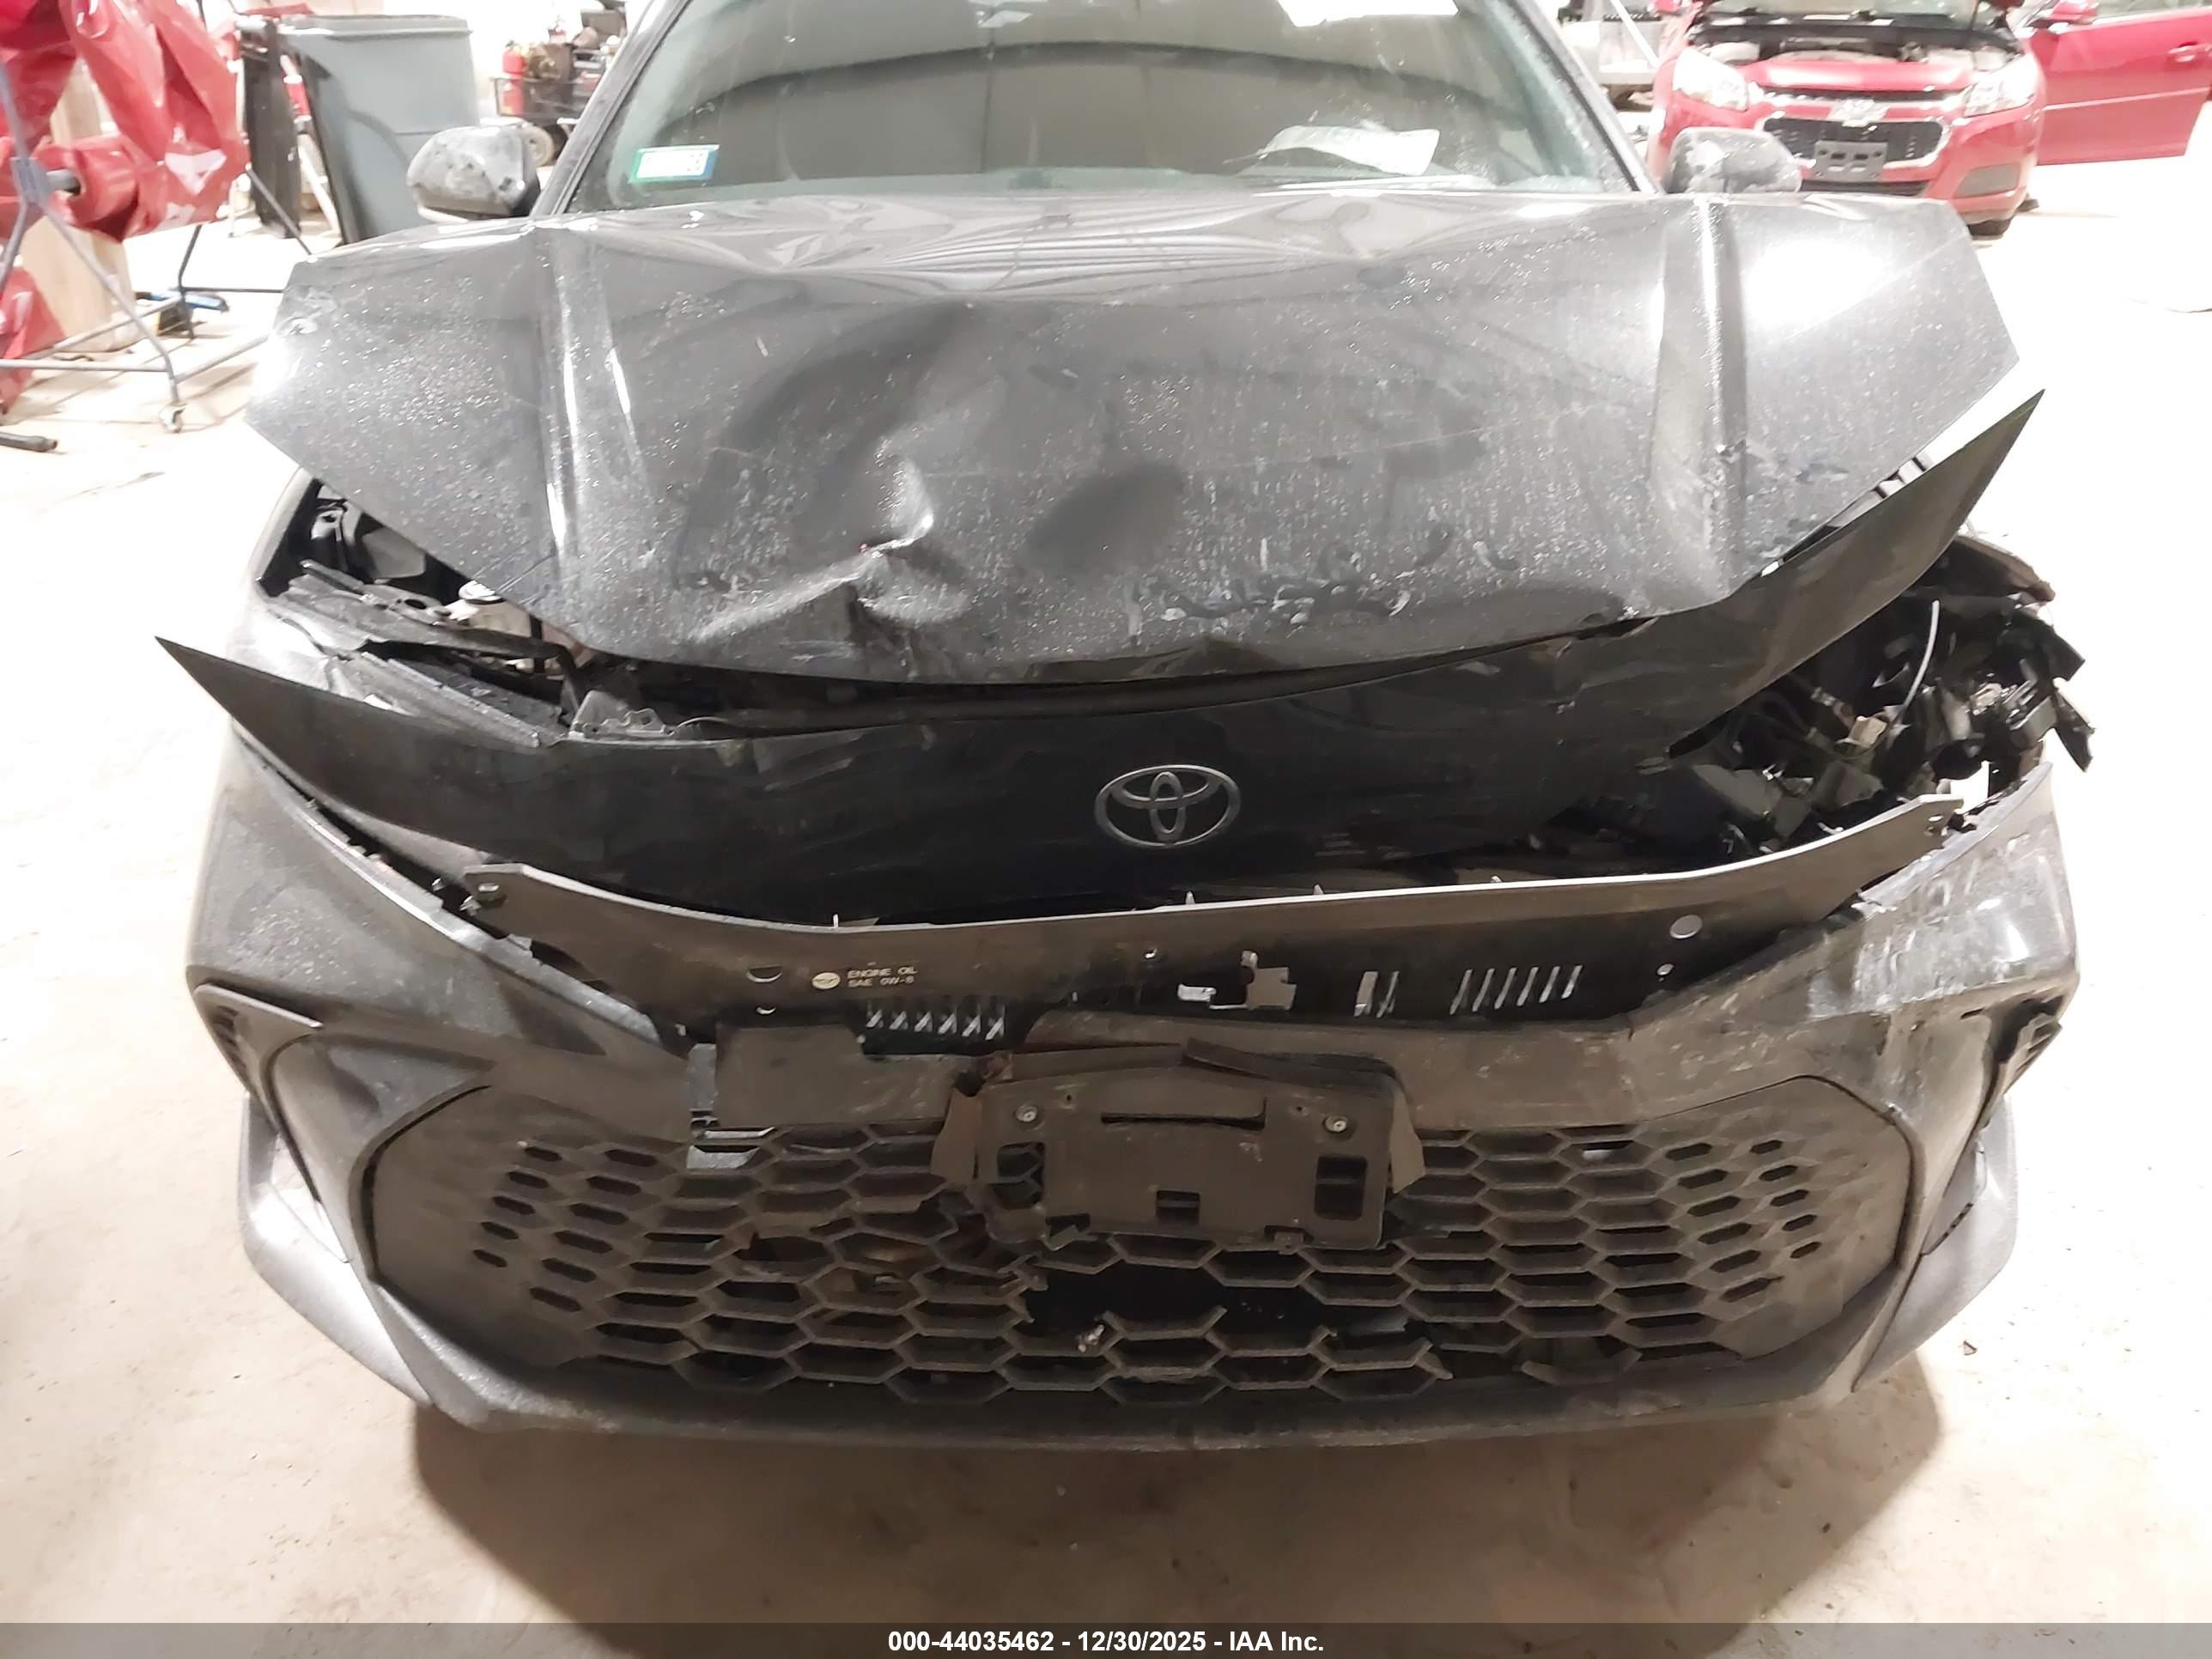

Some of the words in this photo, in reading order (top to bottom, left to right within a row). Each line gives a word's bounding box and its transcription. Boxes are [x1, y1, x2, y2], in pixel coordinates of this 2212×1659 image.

[847, 968, 892, 979] ENGINE
[897, 966, 918, 975] OIL
[848, 978, 873, 988] SAE
